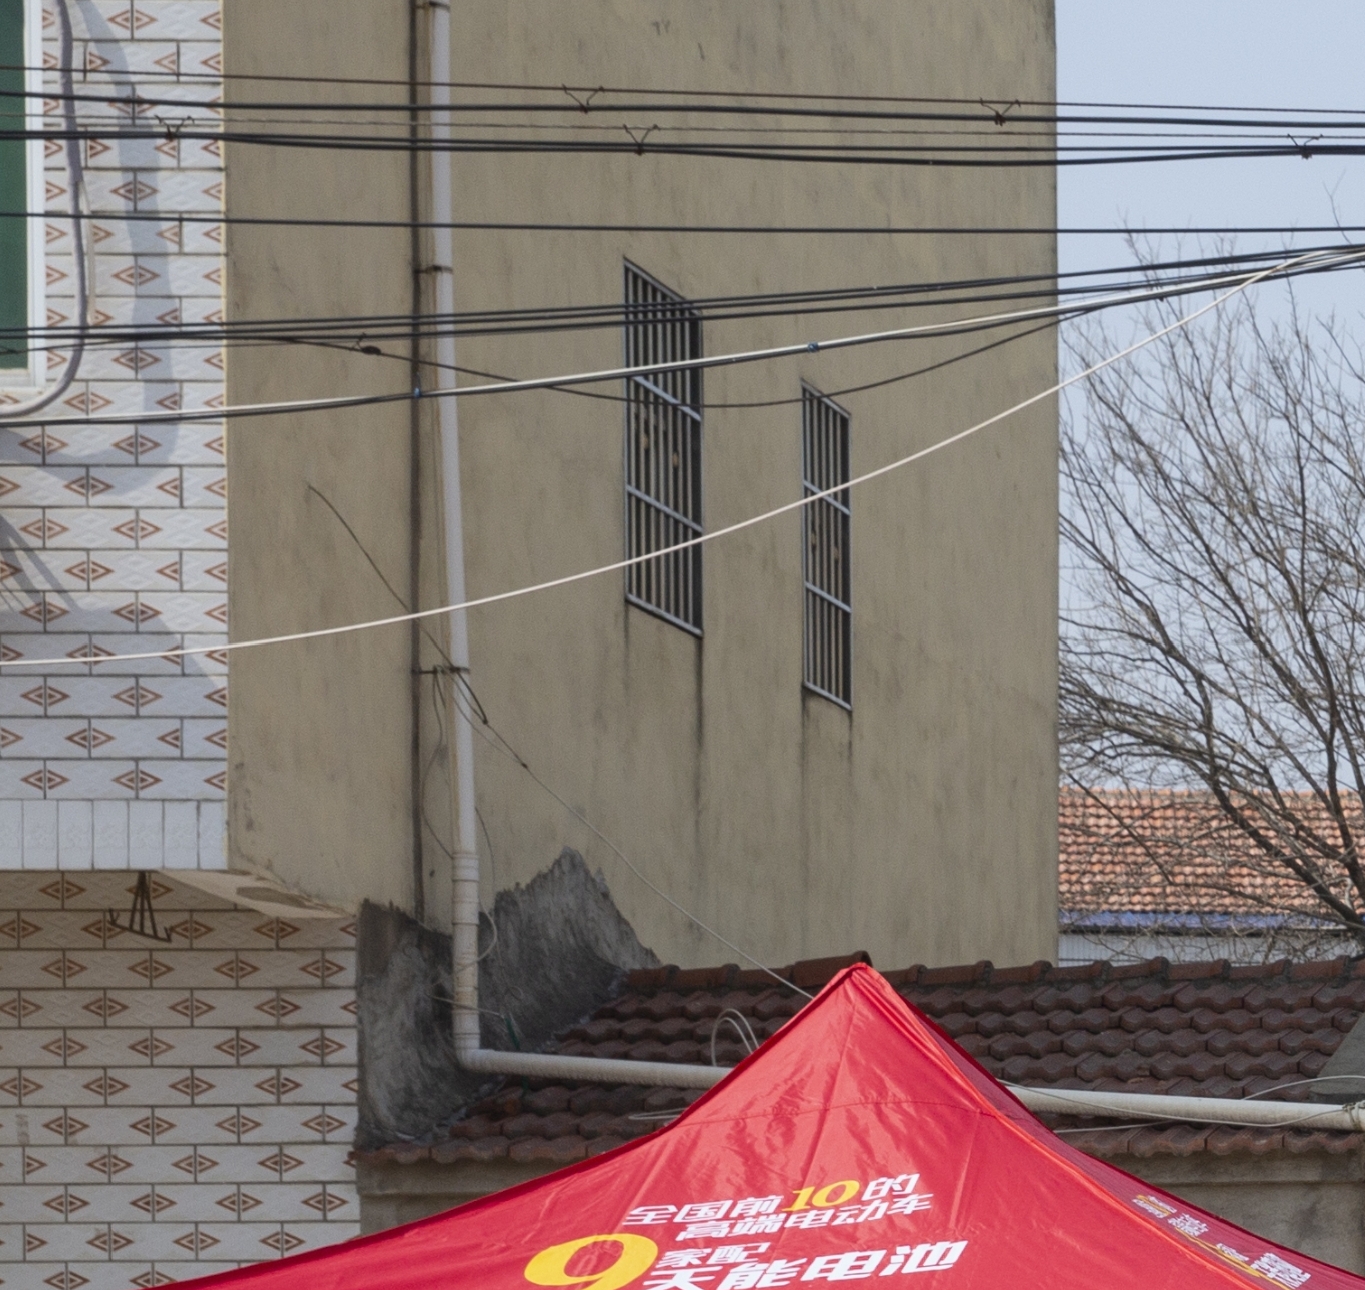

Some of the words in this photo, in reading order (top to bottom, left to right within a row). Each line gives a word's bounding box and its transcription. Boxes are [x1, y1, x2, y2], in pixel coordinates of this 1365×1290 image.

[622, 1173, 920, 1226] 全国前10的
[675, 1193, 934, 1242] 高端电动车
[656, 1242, 771, 1268] 家配
